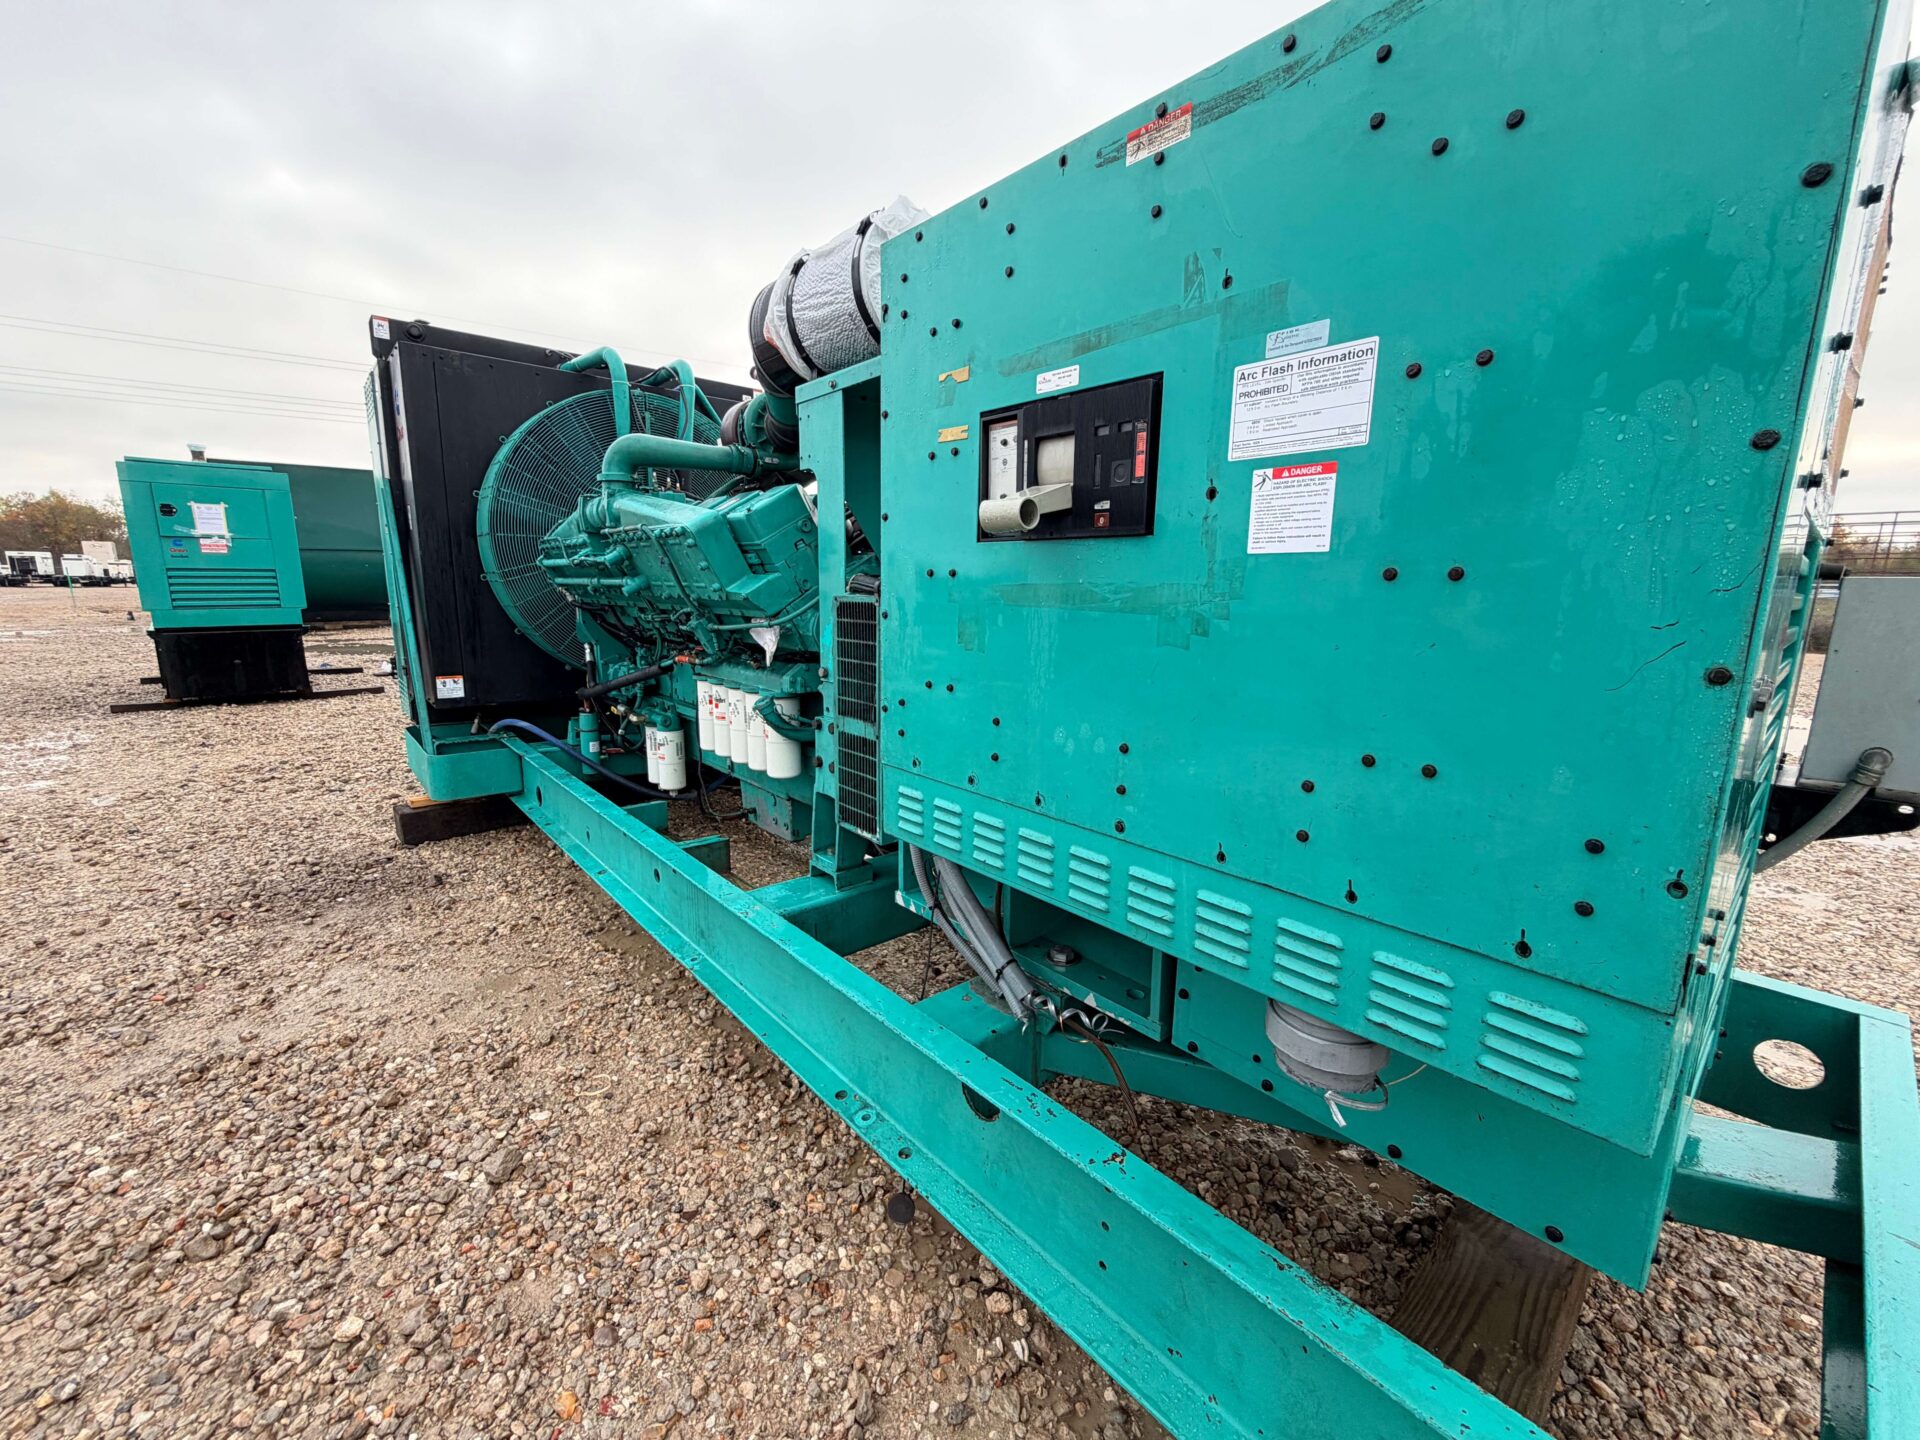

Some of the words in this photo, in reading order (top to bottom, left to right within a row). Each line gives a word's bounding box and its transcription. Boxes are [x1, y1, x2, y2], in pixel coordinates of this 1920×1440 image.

[1148, 110, 1181, 130] DANGER
[1238, 370, 1257, 382] Arc
[1261, 362, 1293, 378] Flash
[1298, 347, 1374, 370] Information
[1238, 383, 1288, 400] PROHIBITED
[1290, 465, 1322, 475] DANGER
